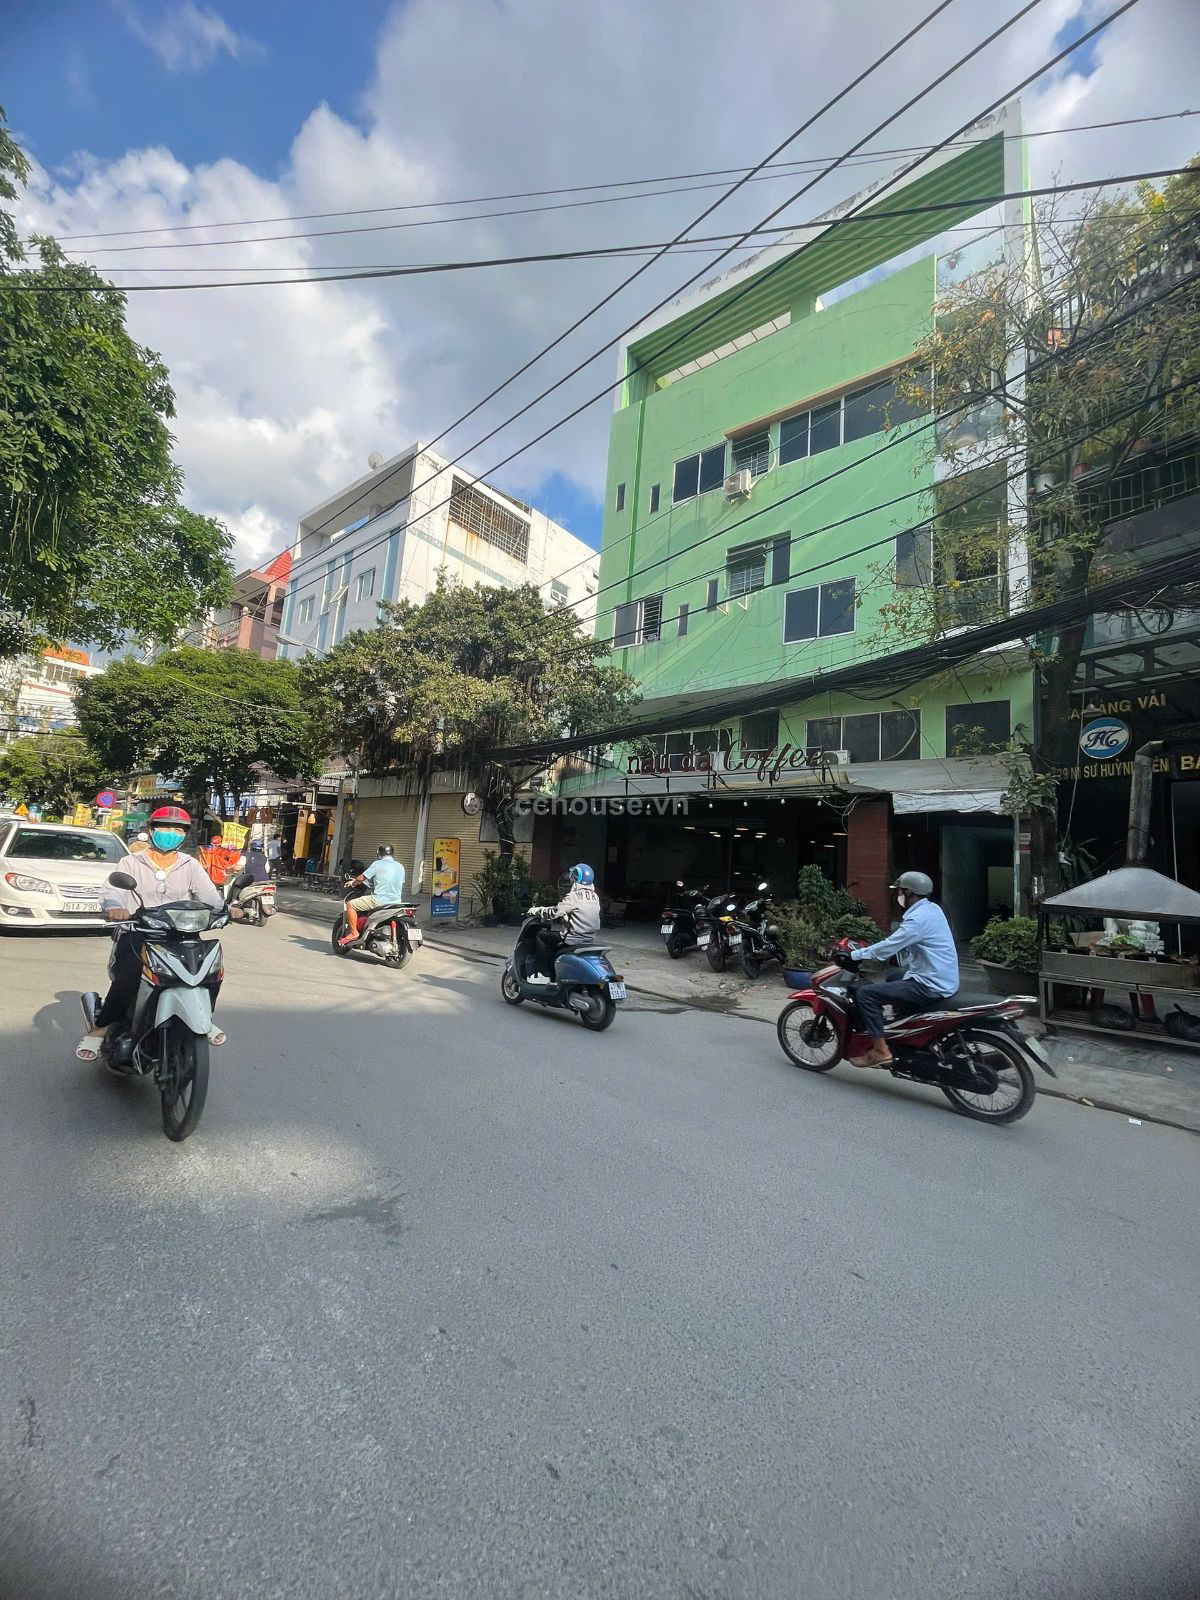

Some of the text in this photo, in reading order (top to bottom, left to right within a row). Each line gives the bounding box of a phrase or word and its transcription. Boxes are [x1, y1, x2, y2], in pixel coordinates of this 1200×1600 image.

[1138, 689, 1166, 710] VẢI
[723, 739, 826, 782] Coffee
[1083, 762, 1098, 778] SƯ
